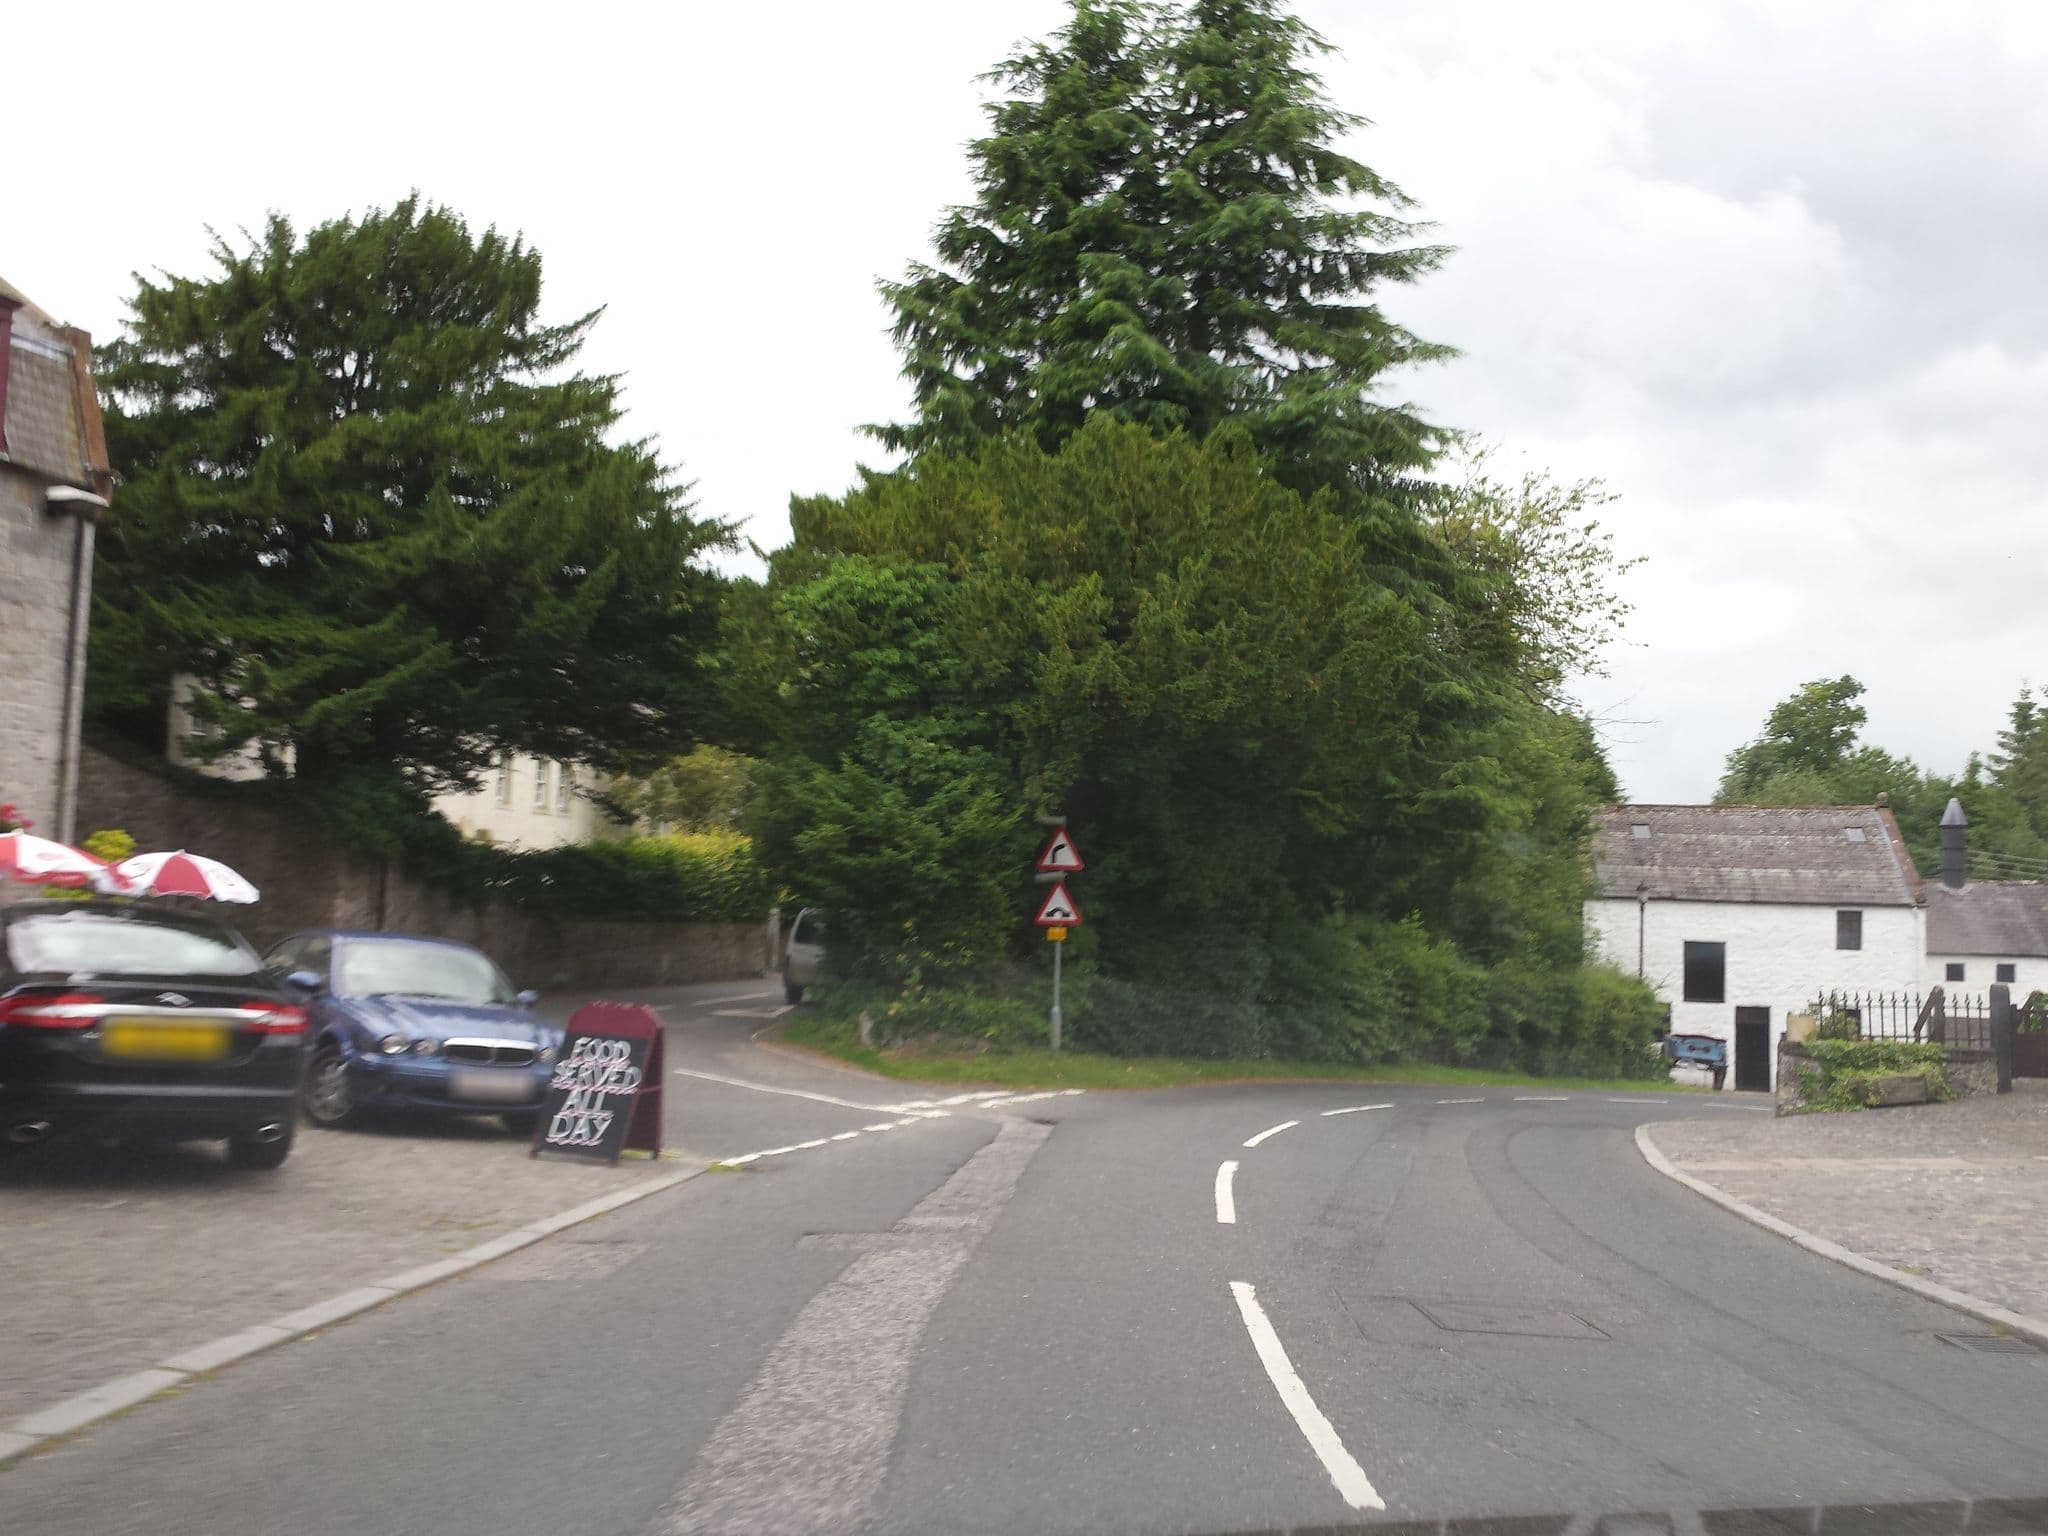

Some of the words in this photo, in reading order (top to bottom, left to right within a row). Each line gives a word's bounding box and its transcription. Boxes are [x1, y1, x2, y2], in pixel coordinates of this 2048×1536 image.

[571, 1037, 631, 1064] FOOD
[552, 1060, 642, 1091] SERVED
[561, 1089, 615, 1115] ALL
[547, 1115, 614, 1143] DAY
